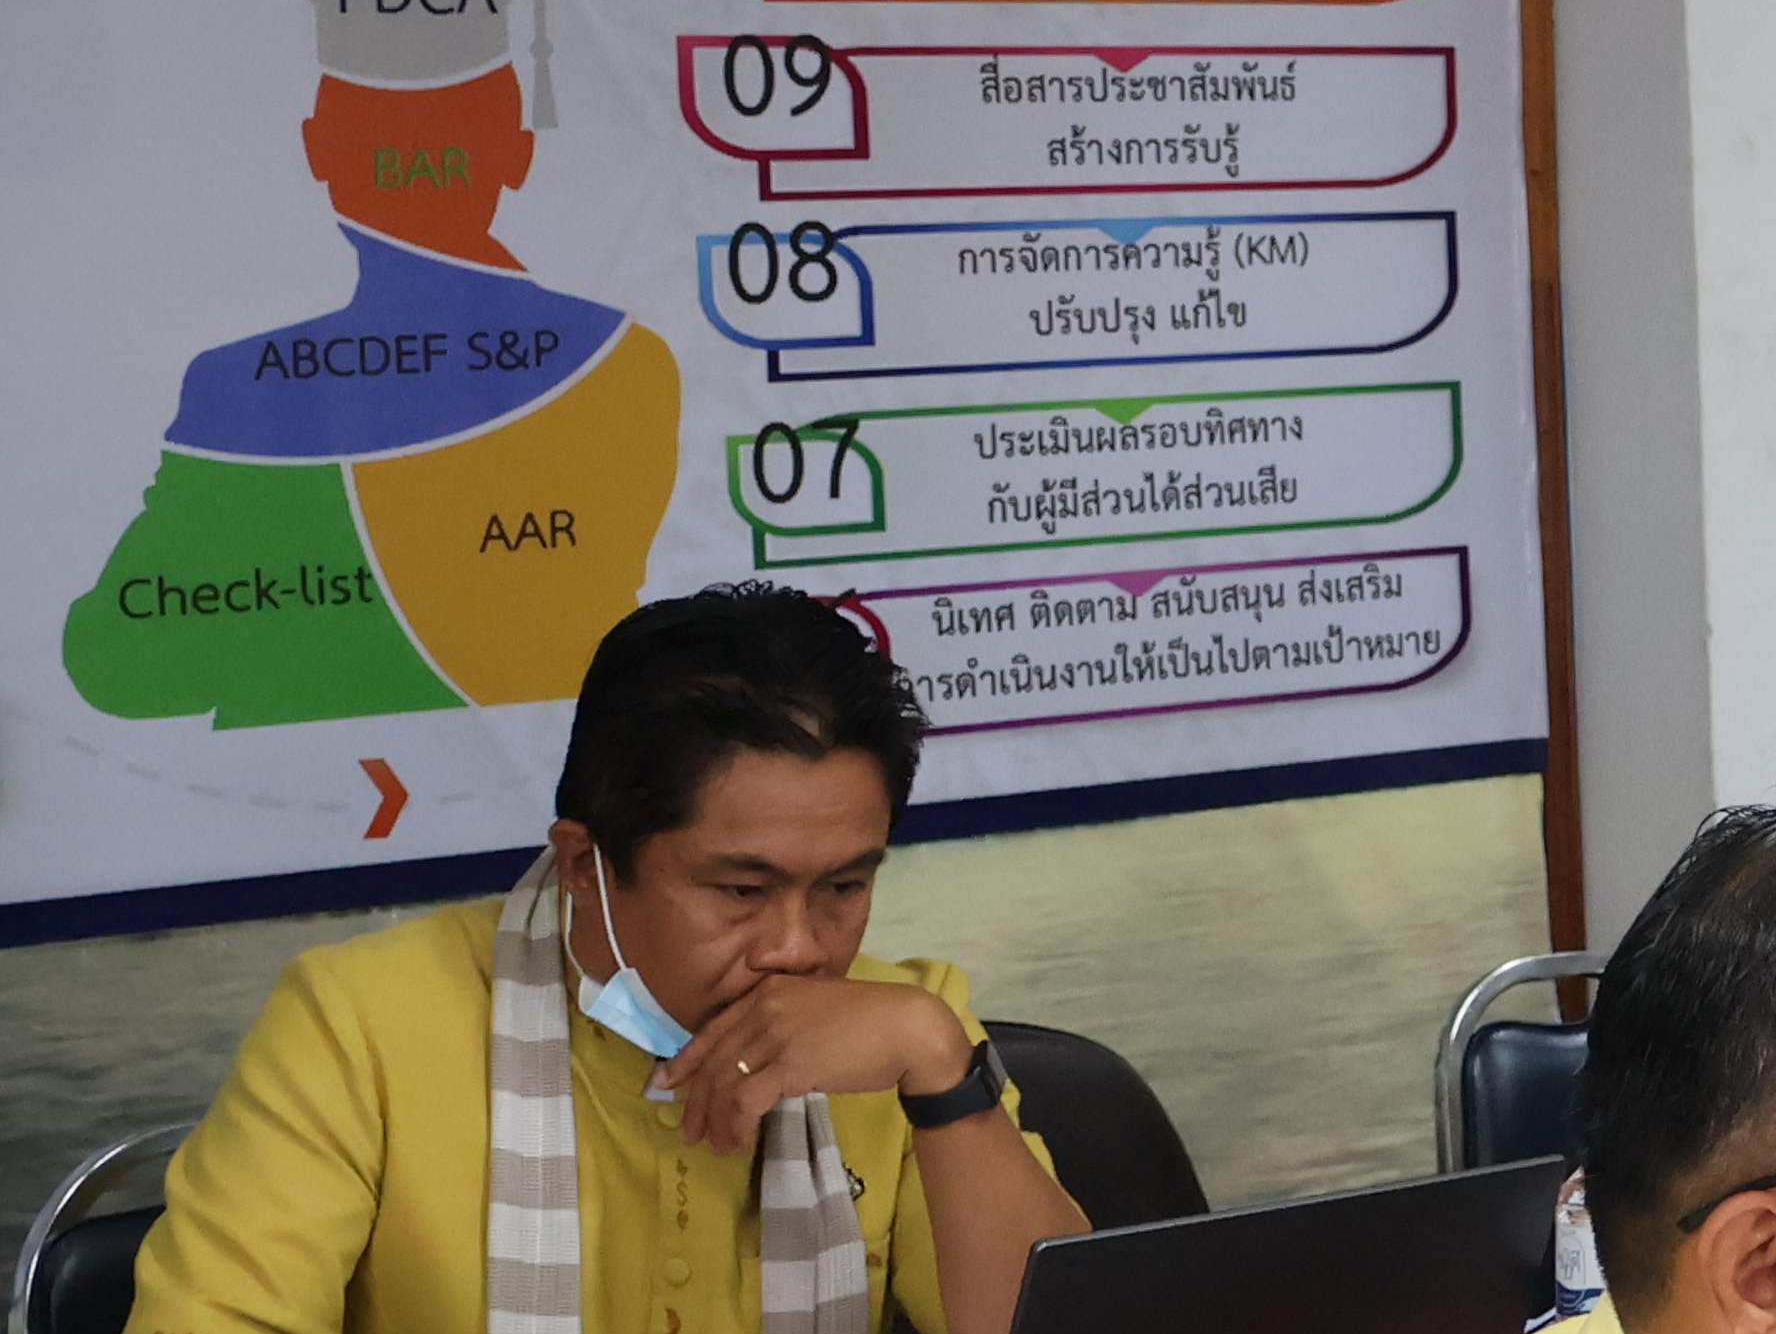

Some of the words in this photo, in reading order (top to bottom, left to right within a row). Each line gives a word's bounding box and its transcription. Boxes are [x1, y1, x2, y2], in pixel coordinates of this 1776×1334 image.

[723, 34, 832, 117] 09
[979, 53, 1298, 106] สื่อสารประชาสัมพันธ์
[373, 147, 471, 190] BAR
[1046, 123, 1241, 178] สร้างการรับรู้
[728, 219, 839, 304] 08
[957, 229, 1223, 281] การจัดการความรู้
[1232, 233, 1311, 271] (KM)
[1030, 293, 1156, 346] ปรับปรุง
[1172, 288, 1249, 332] แก้ไข
[255, 333, 448, 382] ABCDEF
[466, 328, 561, 370] S&P
[752, 417, 861, 504] 07
[973, 408, 1305, 463] ประเมินผลรอบทิศทาง
[478, 509, 578, 554] AAR
[987, 471, 1300, 536] กับผู้มีส่วนได้ส่วนเสีย
[118, 564, 374, 622] Check-list
[932, 596, 1016, 637] นิเทศ
[1031, 589, 1139, 630] ติดตาม
[1151, 574, 1286, 619] สนับสนุน
[1298, 563, 1404, 607] ส่งเสริม
